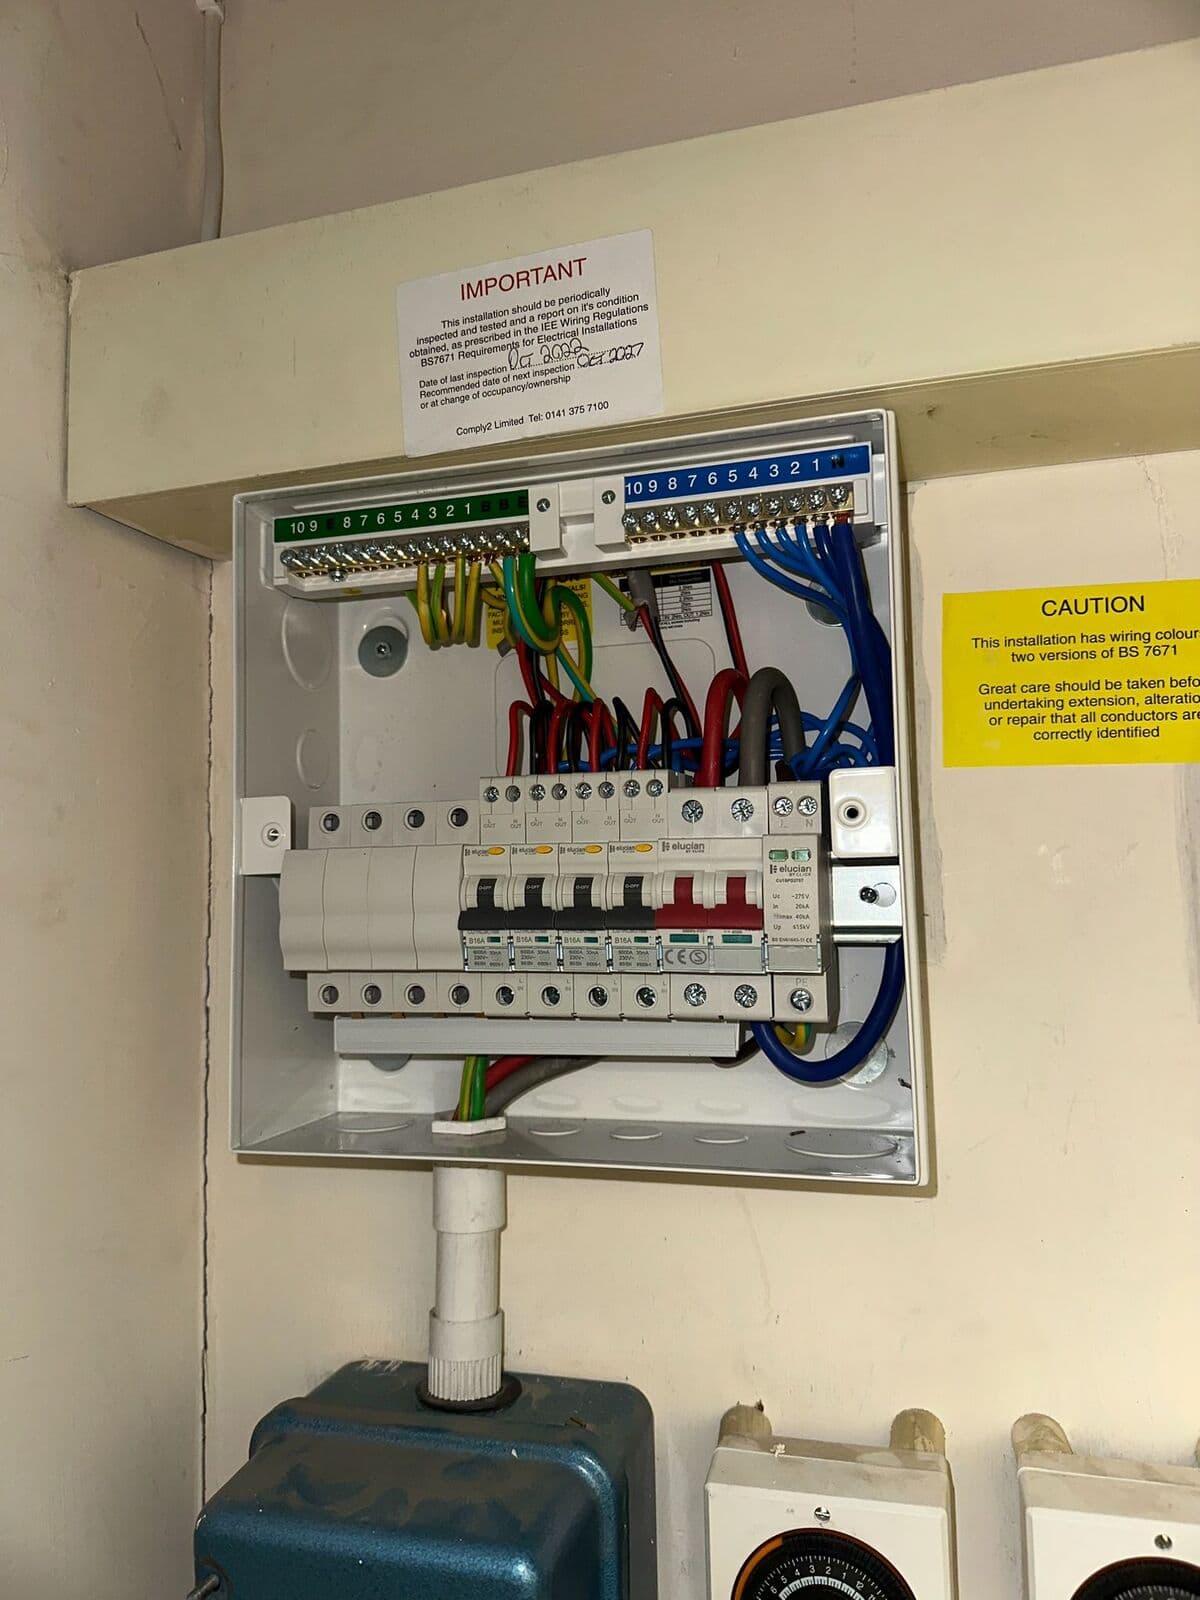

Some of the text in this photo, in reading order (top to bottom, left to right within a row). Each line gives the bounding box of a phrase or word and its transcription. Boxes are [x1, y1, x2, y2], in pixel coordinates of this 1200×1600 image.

[461, 258, 587, 300] IMPORTANT
[441, 288, 611, 329] This installation should be periodically
[416, 330, 458, 346] inspected
[461, 326, 477, 337] and
[480, 321, 507, 333] tested
[510, 316, 527, 327] and
[538, 309, 564, 321] report
[582, 303, 594, 312] it's
[597, 294, 639, 309] condition
[409, 303, 649, 358] obtained, as prescribed in the IEE Wiring Regulations
[421, 318, 638, 367] BS7671 Requirements for Electrical Installations
[609, 342, 644, 363] 2027
[419, 366, 508, 389] Date of last inspection
[420, 362, 575, 399] Recommended date of next inspection
[431, 400, 439, 408] at
[440, 394, 470, 405] change
[472, 391, 480, 400] of
[482, 375, 571, 398] occupancy/ownership
[456, 401, 609, 436] Comply2 Limited Tel: 0141 375 7100
[626, 482, 643, 495] 10
[648, 480, 658, 492] 9
[668, 477, 677, 490] 8
[688, 475, 697, 488] 7
[708, 472, 718, 485] 6
[728, 470, 738, 483] 5
[749, 467, 758, 479] 4
[770, 464, 779, 477] 3
[791, 462, 800, 475] 2
[812, 459, 819, 472] 1
[290, 522, 305, 534] 10
[310, 520, 318, 532] 9
[344, 517, 351, 528] 8
[360, 515, 368, 526] 7
[377, 513, 385, 525] 6
[394, 511, 402, 523] 5
[412, 509, 420, 520] 4
[429, 507, 437, 519] 3
[446, 505, 455, 517] 2
[465, 503, 470, 515] 1
[1041, 595, 1145, 617] CAUTION
[972, 628, 1200, 649] This installation has wiring colour
[1011, 645, 1178, 663] two versions of BS 7671
[978, 683, 1017, 696] Great
[1021, 684, 1051, 694] care
[1055, 680, 1101, 693] should
[1105, 679, 1122, 691] be
[1127, 677, 1165, 690] taken
[984, 697, 1064, 711] undertaking
[1069, 696, 1140, 708] extension,
[989, 710, 1200, 728] or repair that all conductors are
[1033, 727, 1160, 742] correctly identified
[806, 820, 814, 828] N
[672, 841, 705, 850] elucian
[780, 865, 812, 873] elucian
[665, 949, 687, 965] CE
[794, 1568, 800, 1576] 4
[809, 1565, 816, 1574] 3
[825, 1566, 832, 1575] 2
[842, 1572, 846, 1580] 1
[781, 1576, 788, 1584] 5
[856, 1580, 864, 1589] 12
